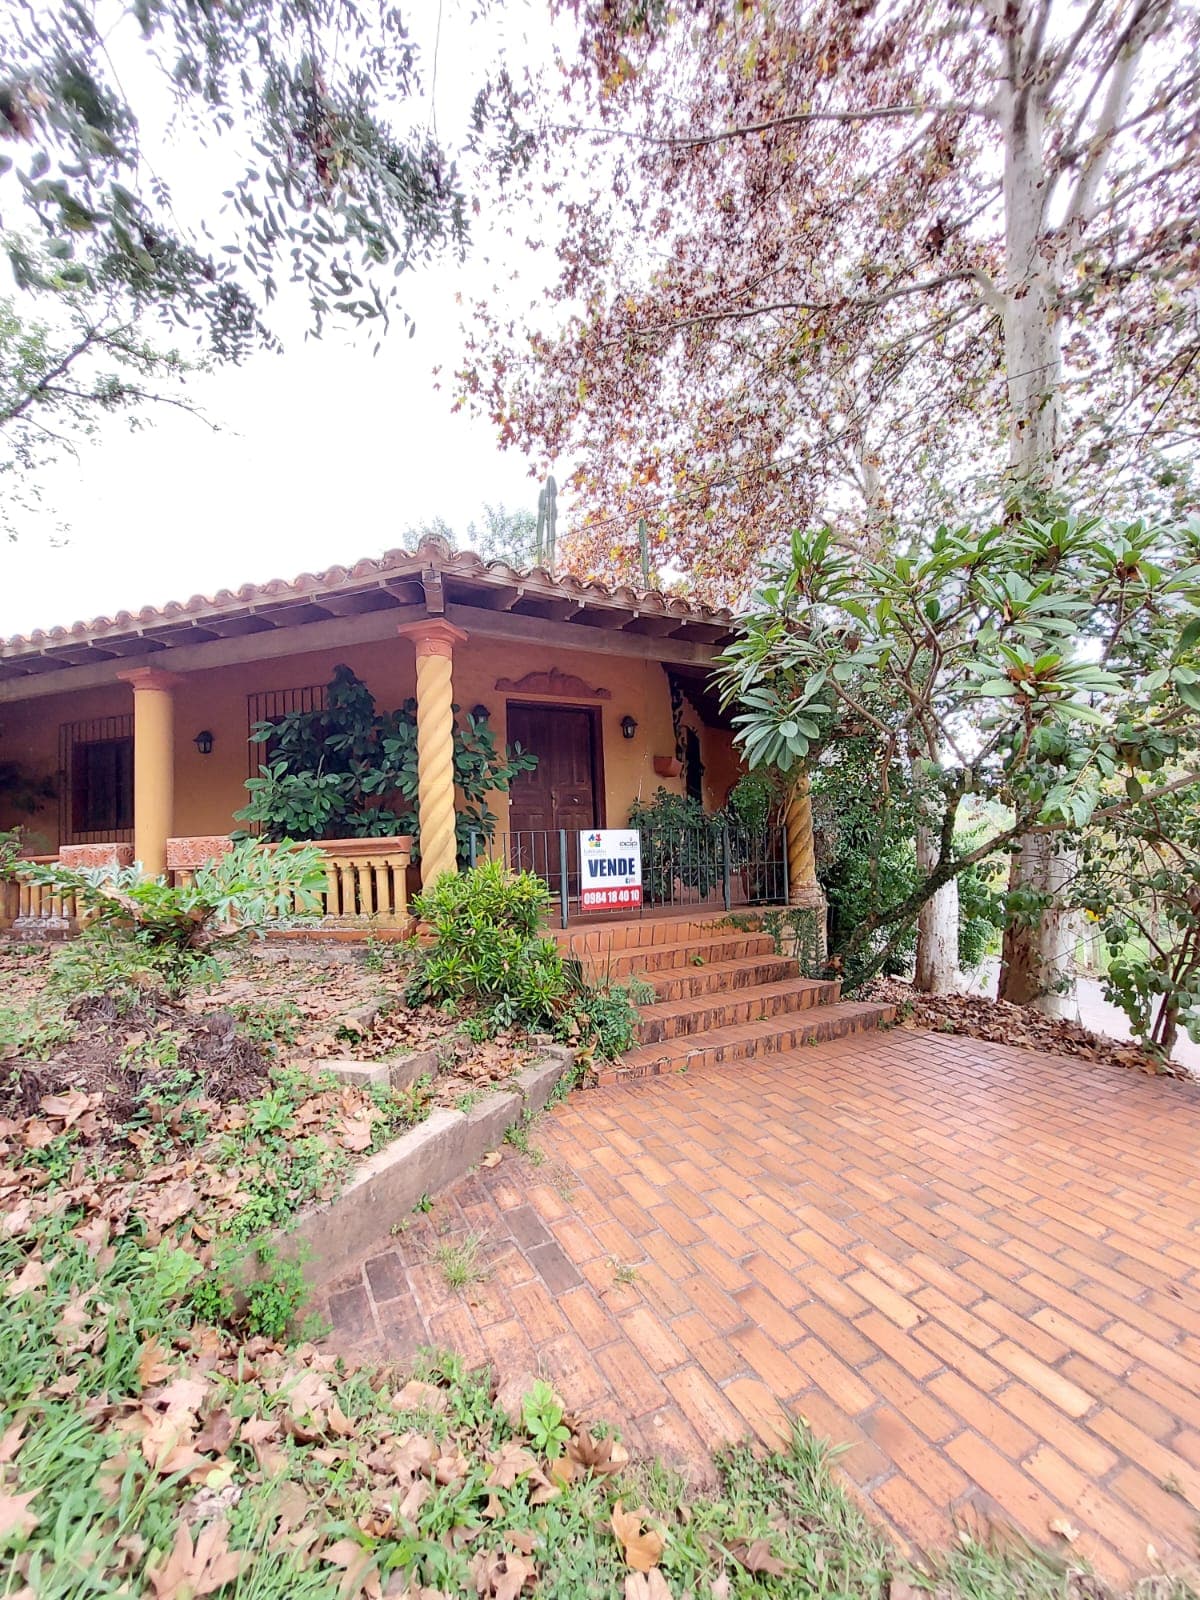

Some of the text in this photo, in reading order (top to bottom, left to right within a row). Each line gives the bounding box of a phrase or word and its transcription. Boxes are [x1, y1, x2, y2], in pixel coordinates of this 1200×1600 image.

[588, 857, 636, 878] VENDE
[584, 889, 640, 905] 0984 18 40 10
